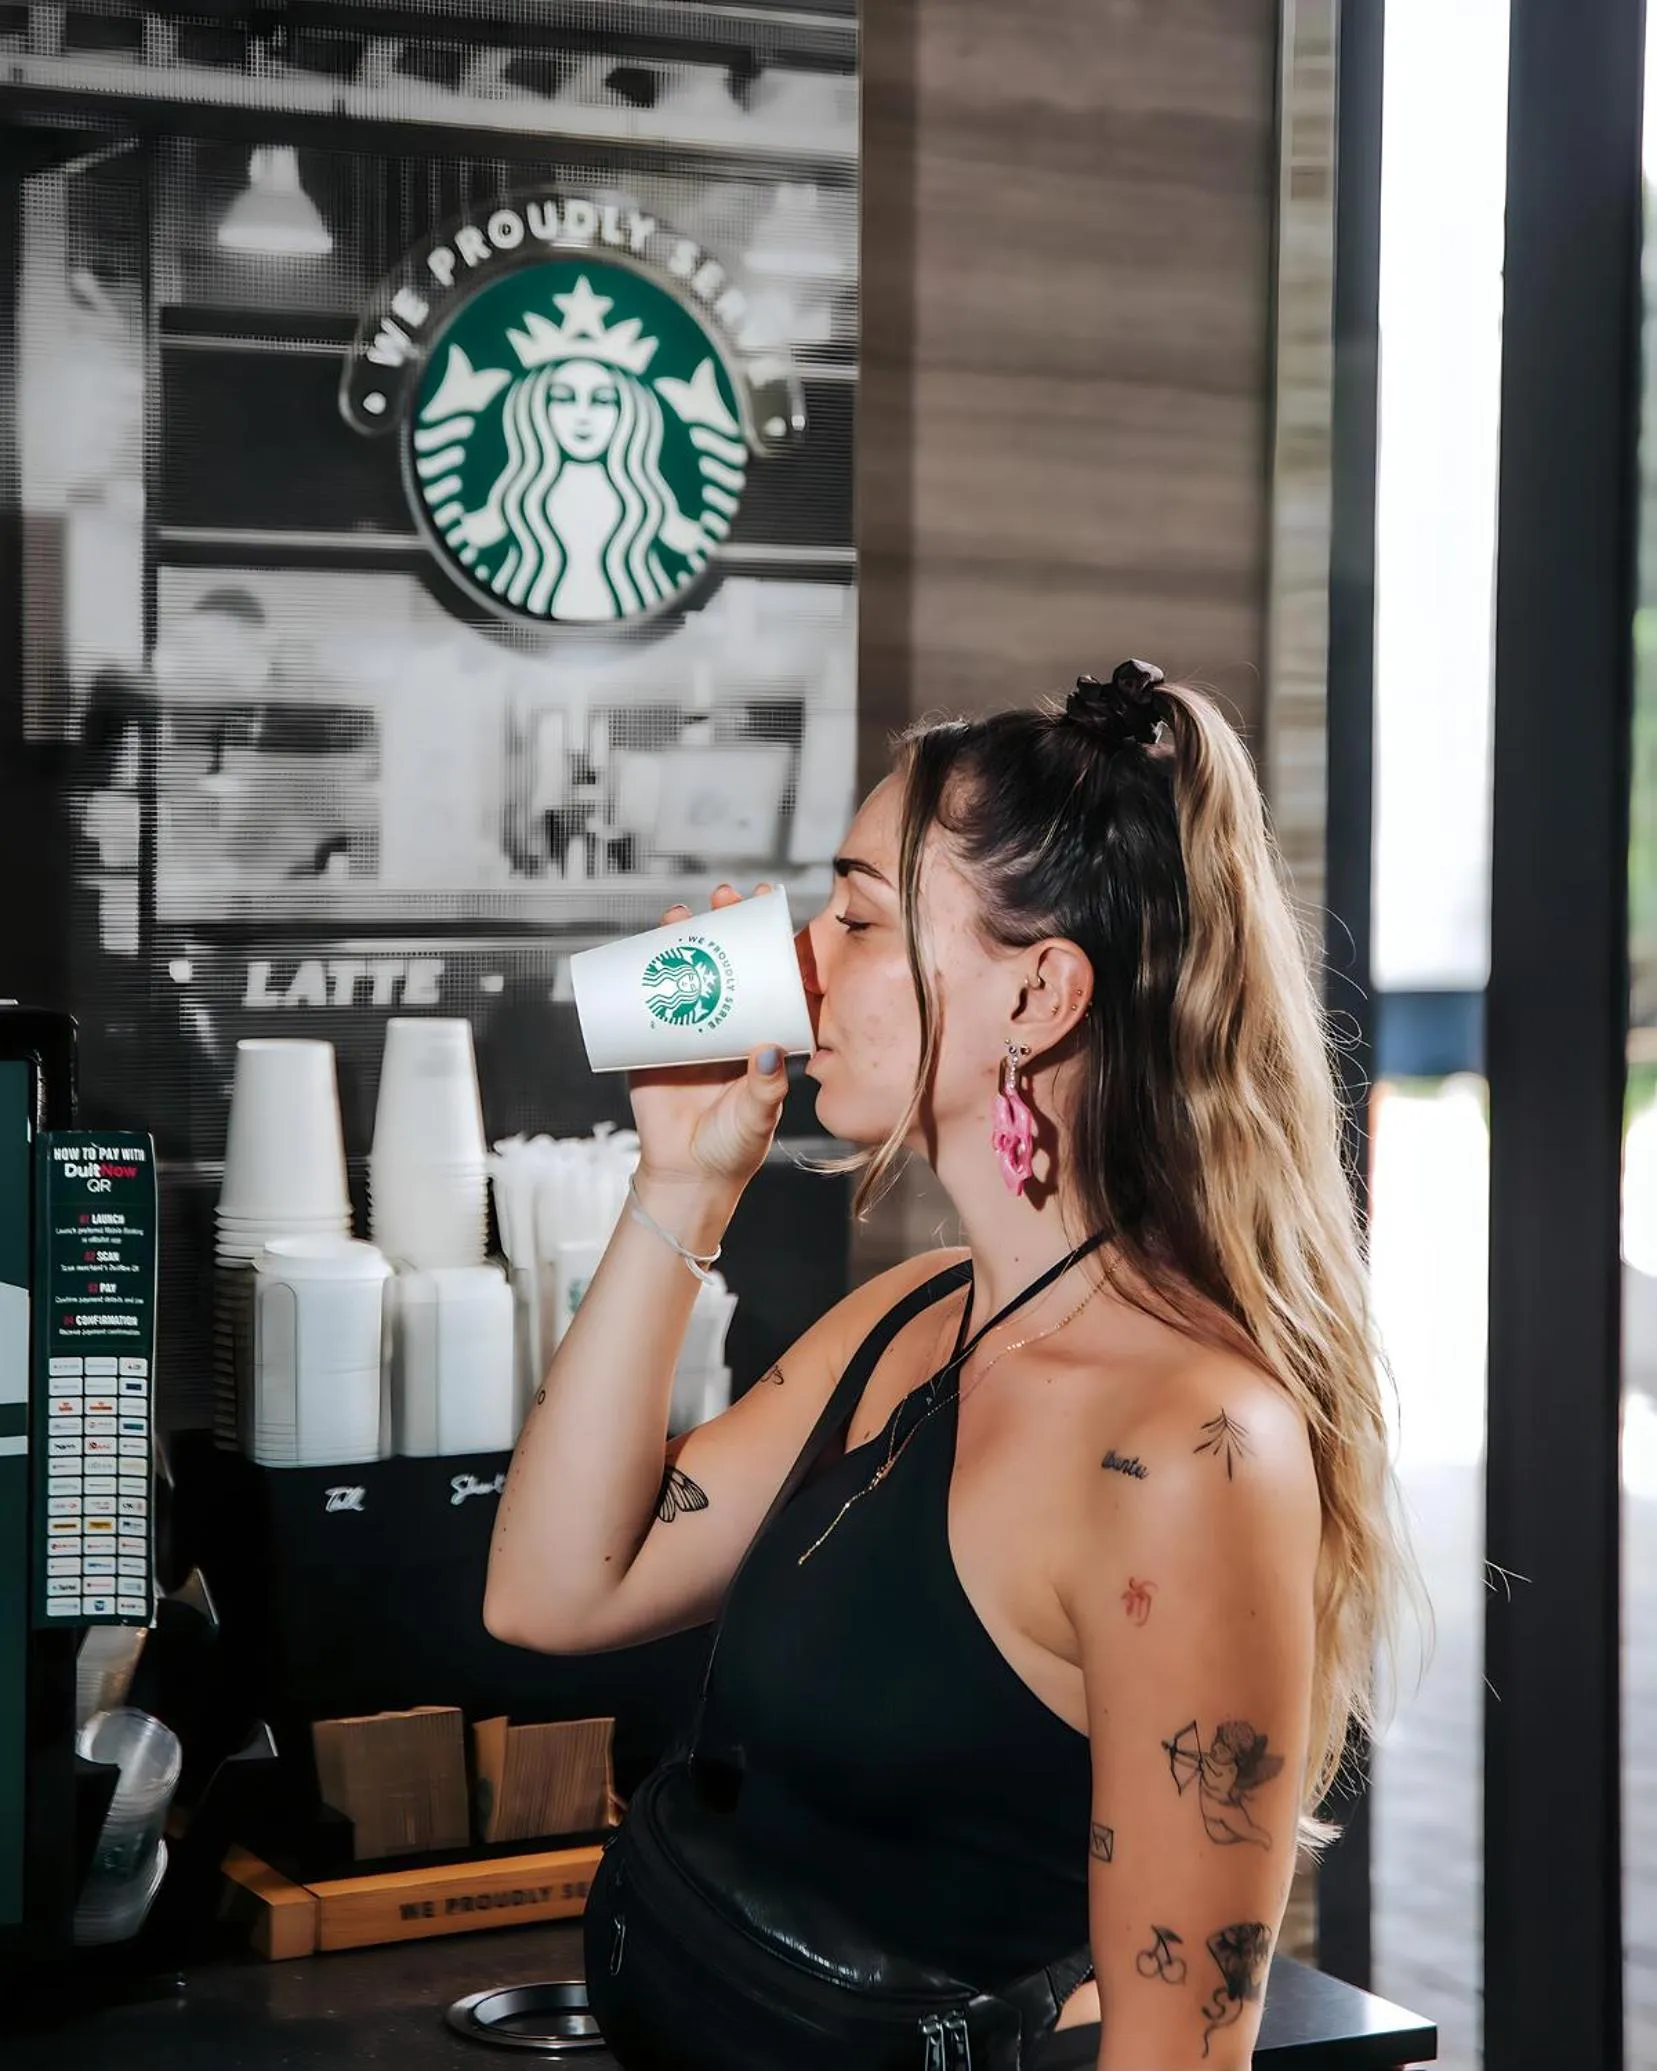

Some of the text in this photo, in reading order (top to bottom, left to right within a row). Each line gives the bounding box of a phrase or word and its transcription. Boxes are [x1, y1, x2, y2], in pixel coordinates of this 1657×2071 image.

[367, 287, 429, 367] WE
[426, 198, 656, 287] PROUDLY
[242, 960, 445, 1007] LATTE
[689, 935, 736, 1030] WE PROUDLY SERVE
[53, 1146, 146, 1162] HOW TO PAY WITH
[64, 1162, 139, 1179] DuitNow
[86, 1178, 112, 1193] QR
[91, 1212, 126, 1225] LAUNCH
[95, 1250, 121, 1263] SCAN
[99, 1282, 118, 1294] PAY
[401, 1901, 435, 1921] WE
[444, 1885, 553, 1915] PROUDLY
